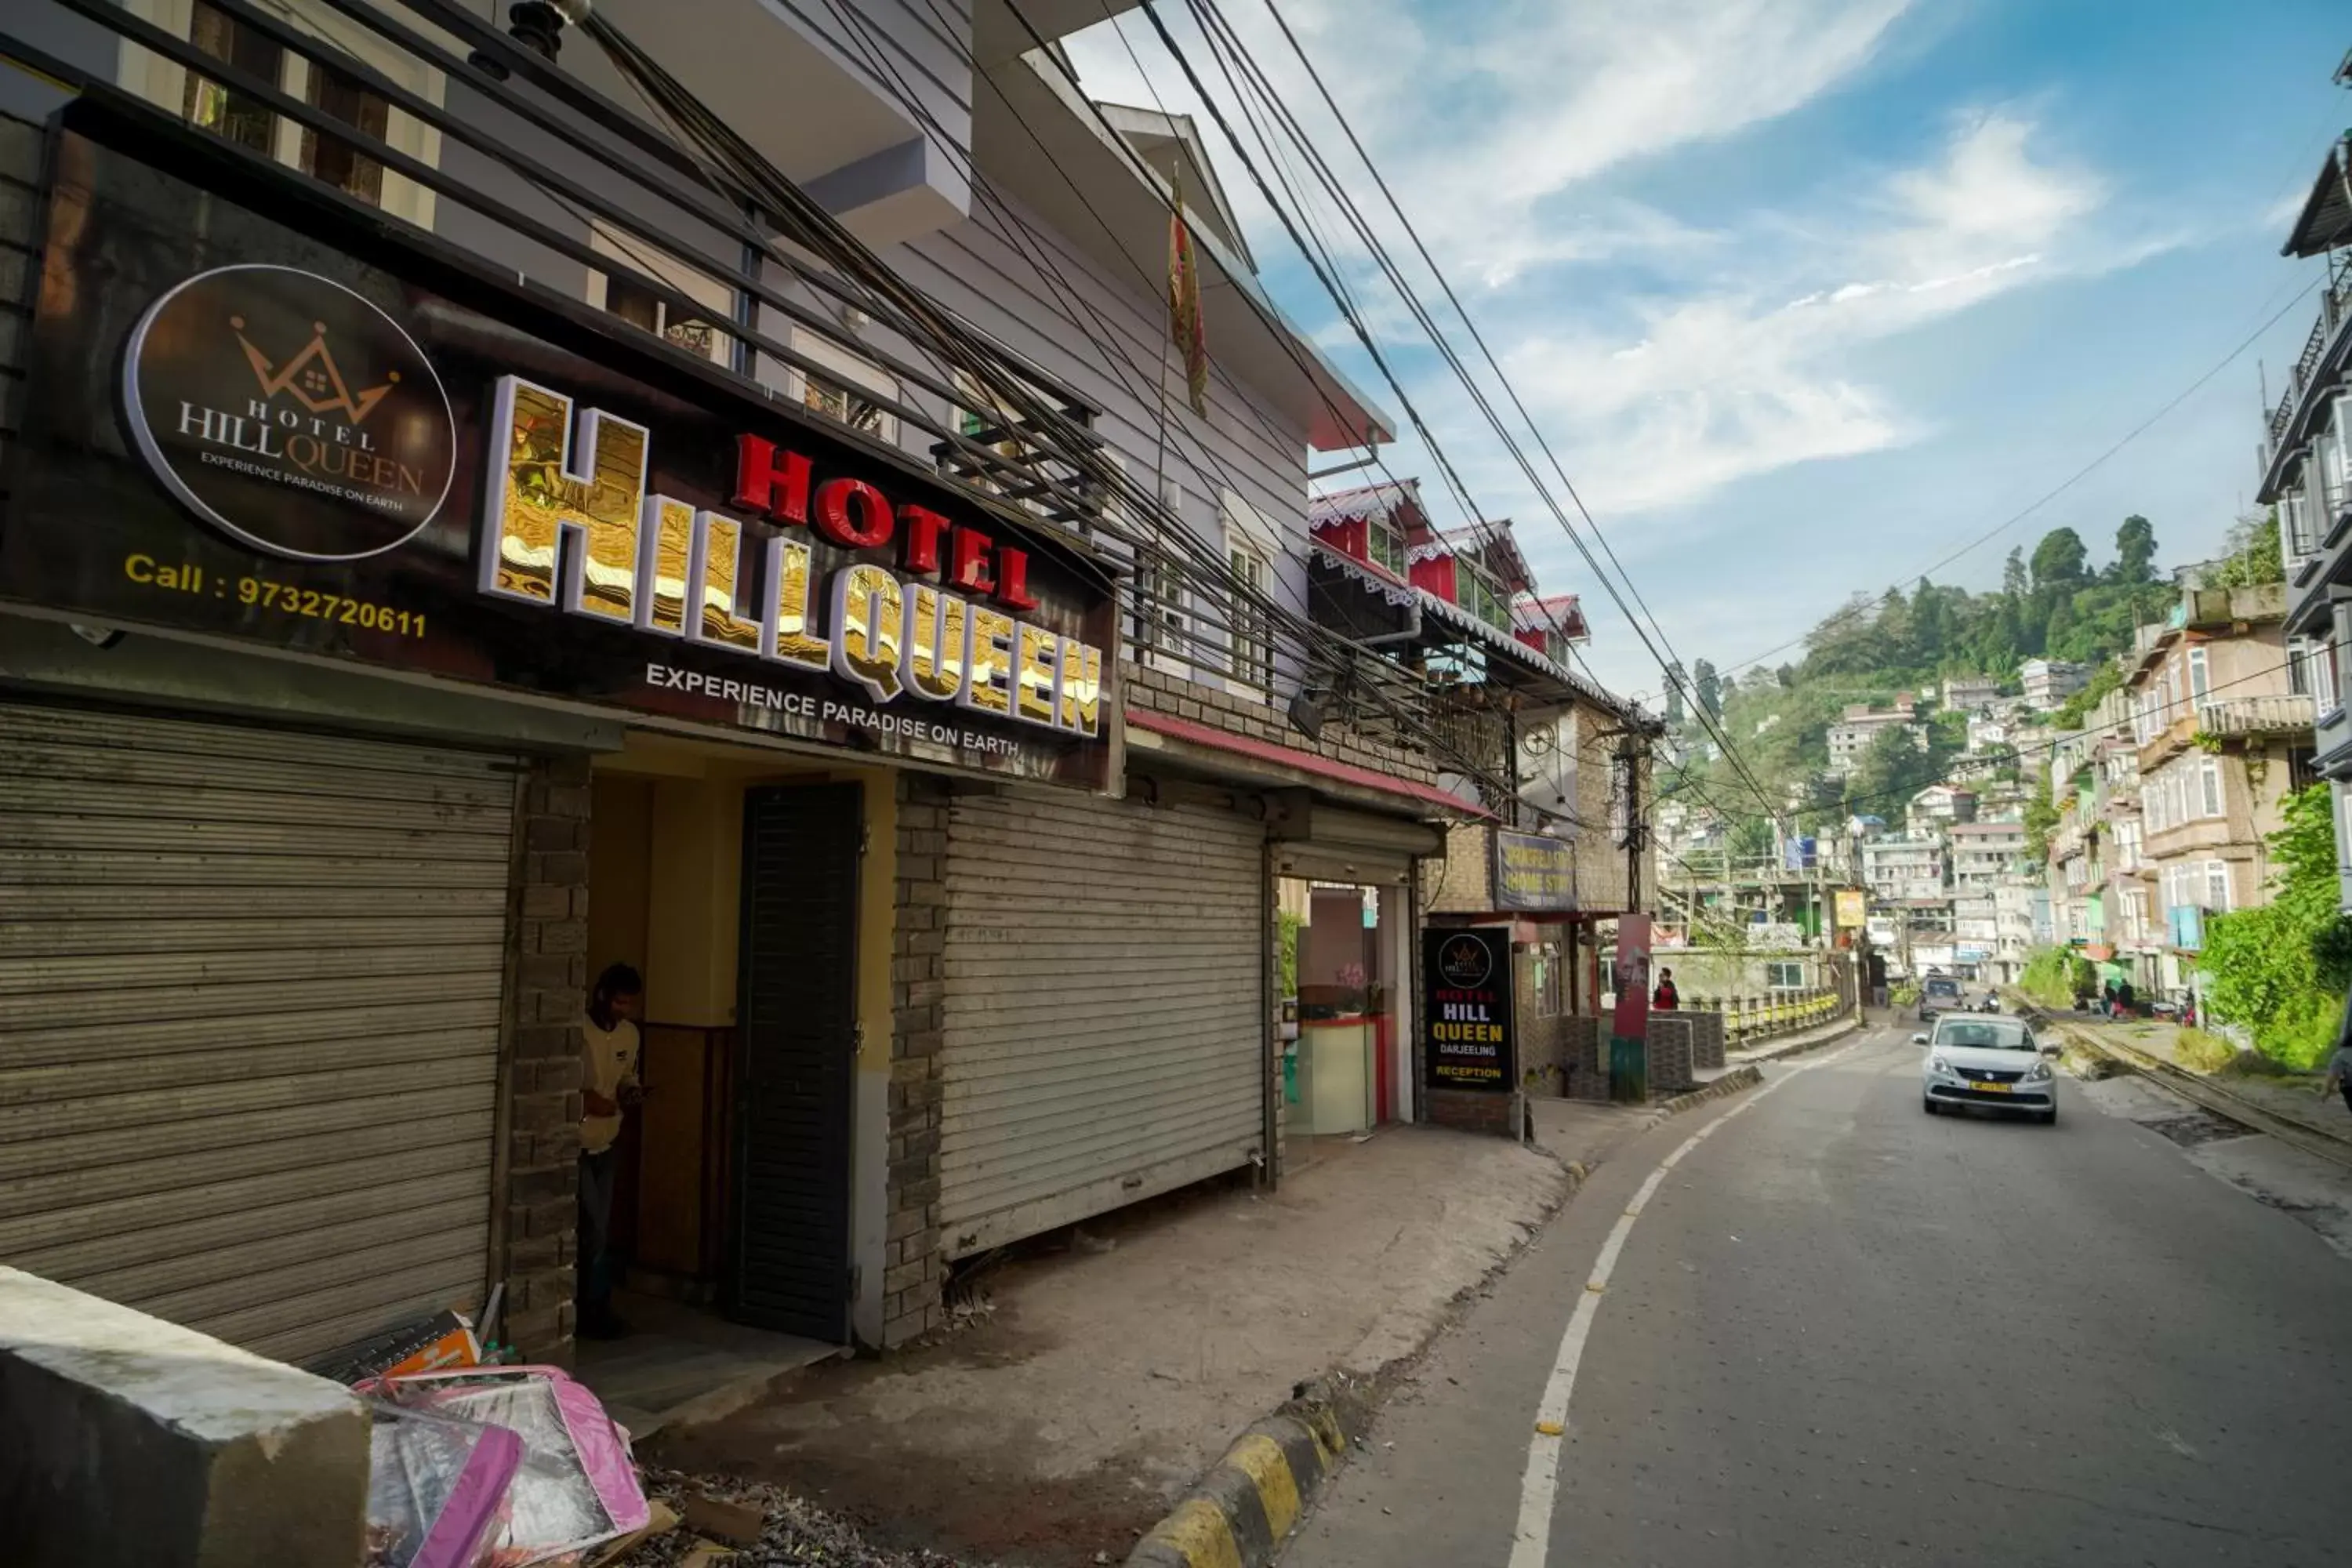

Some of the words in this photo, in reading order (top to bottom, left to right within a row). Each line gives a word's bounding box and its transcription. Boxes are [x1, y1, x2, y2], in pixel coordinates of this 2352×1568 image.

[248, 398, 376, 452] HOTEL
[201, 450, 280, 481] EXPERIENCE
[284, 473, 343, 497] PARADISE
[345, 488, 365, 502] ON
[366, 494, 403, 511] EARTH
[731, 433, 1040, 611] HOTEL
[125, 554, 201, 593] Call
[238, 577, 426, 637] 9732720611
[646, 662, 815, 717] EXPERIENCE
[822, 702, 927, 741] PARADISE
[931, 725, 958, 745] ON
[963, 733, 1020, 757] EARTH
[1433, 1022, 1503, 1042] QUEEN
[1443, 1003, 1490, 1022] HILL
[1436, 1065, 1502, 1079] RECEPTION
[1440, 1044, 1497, 1057] DARJEELING
